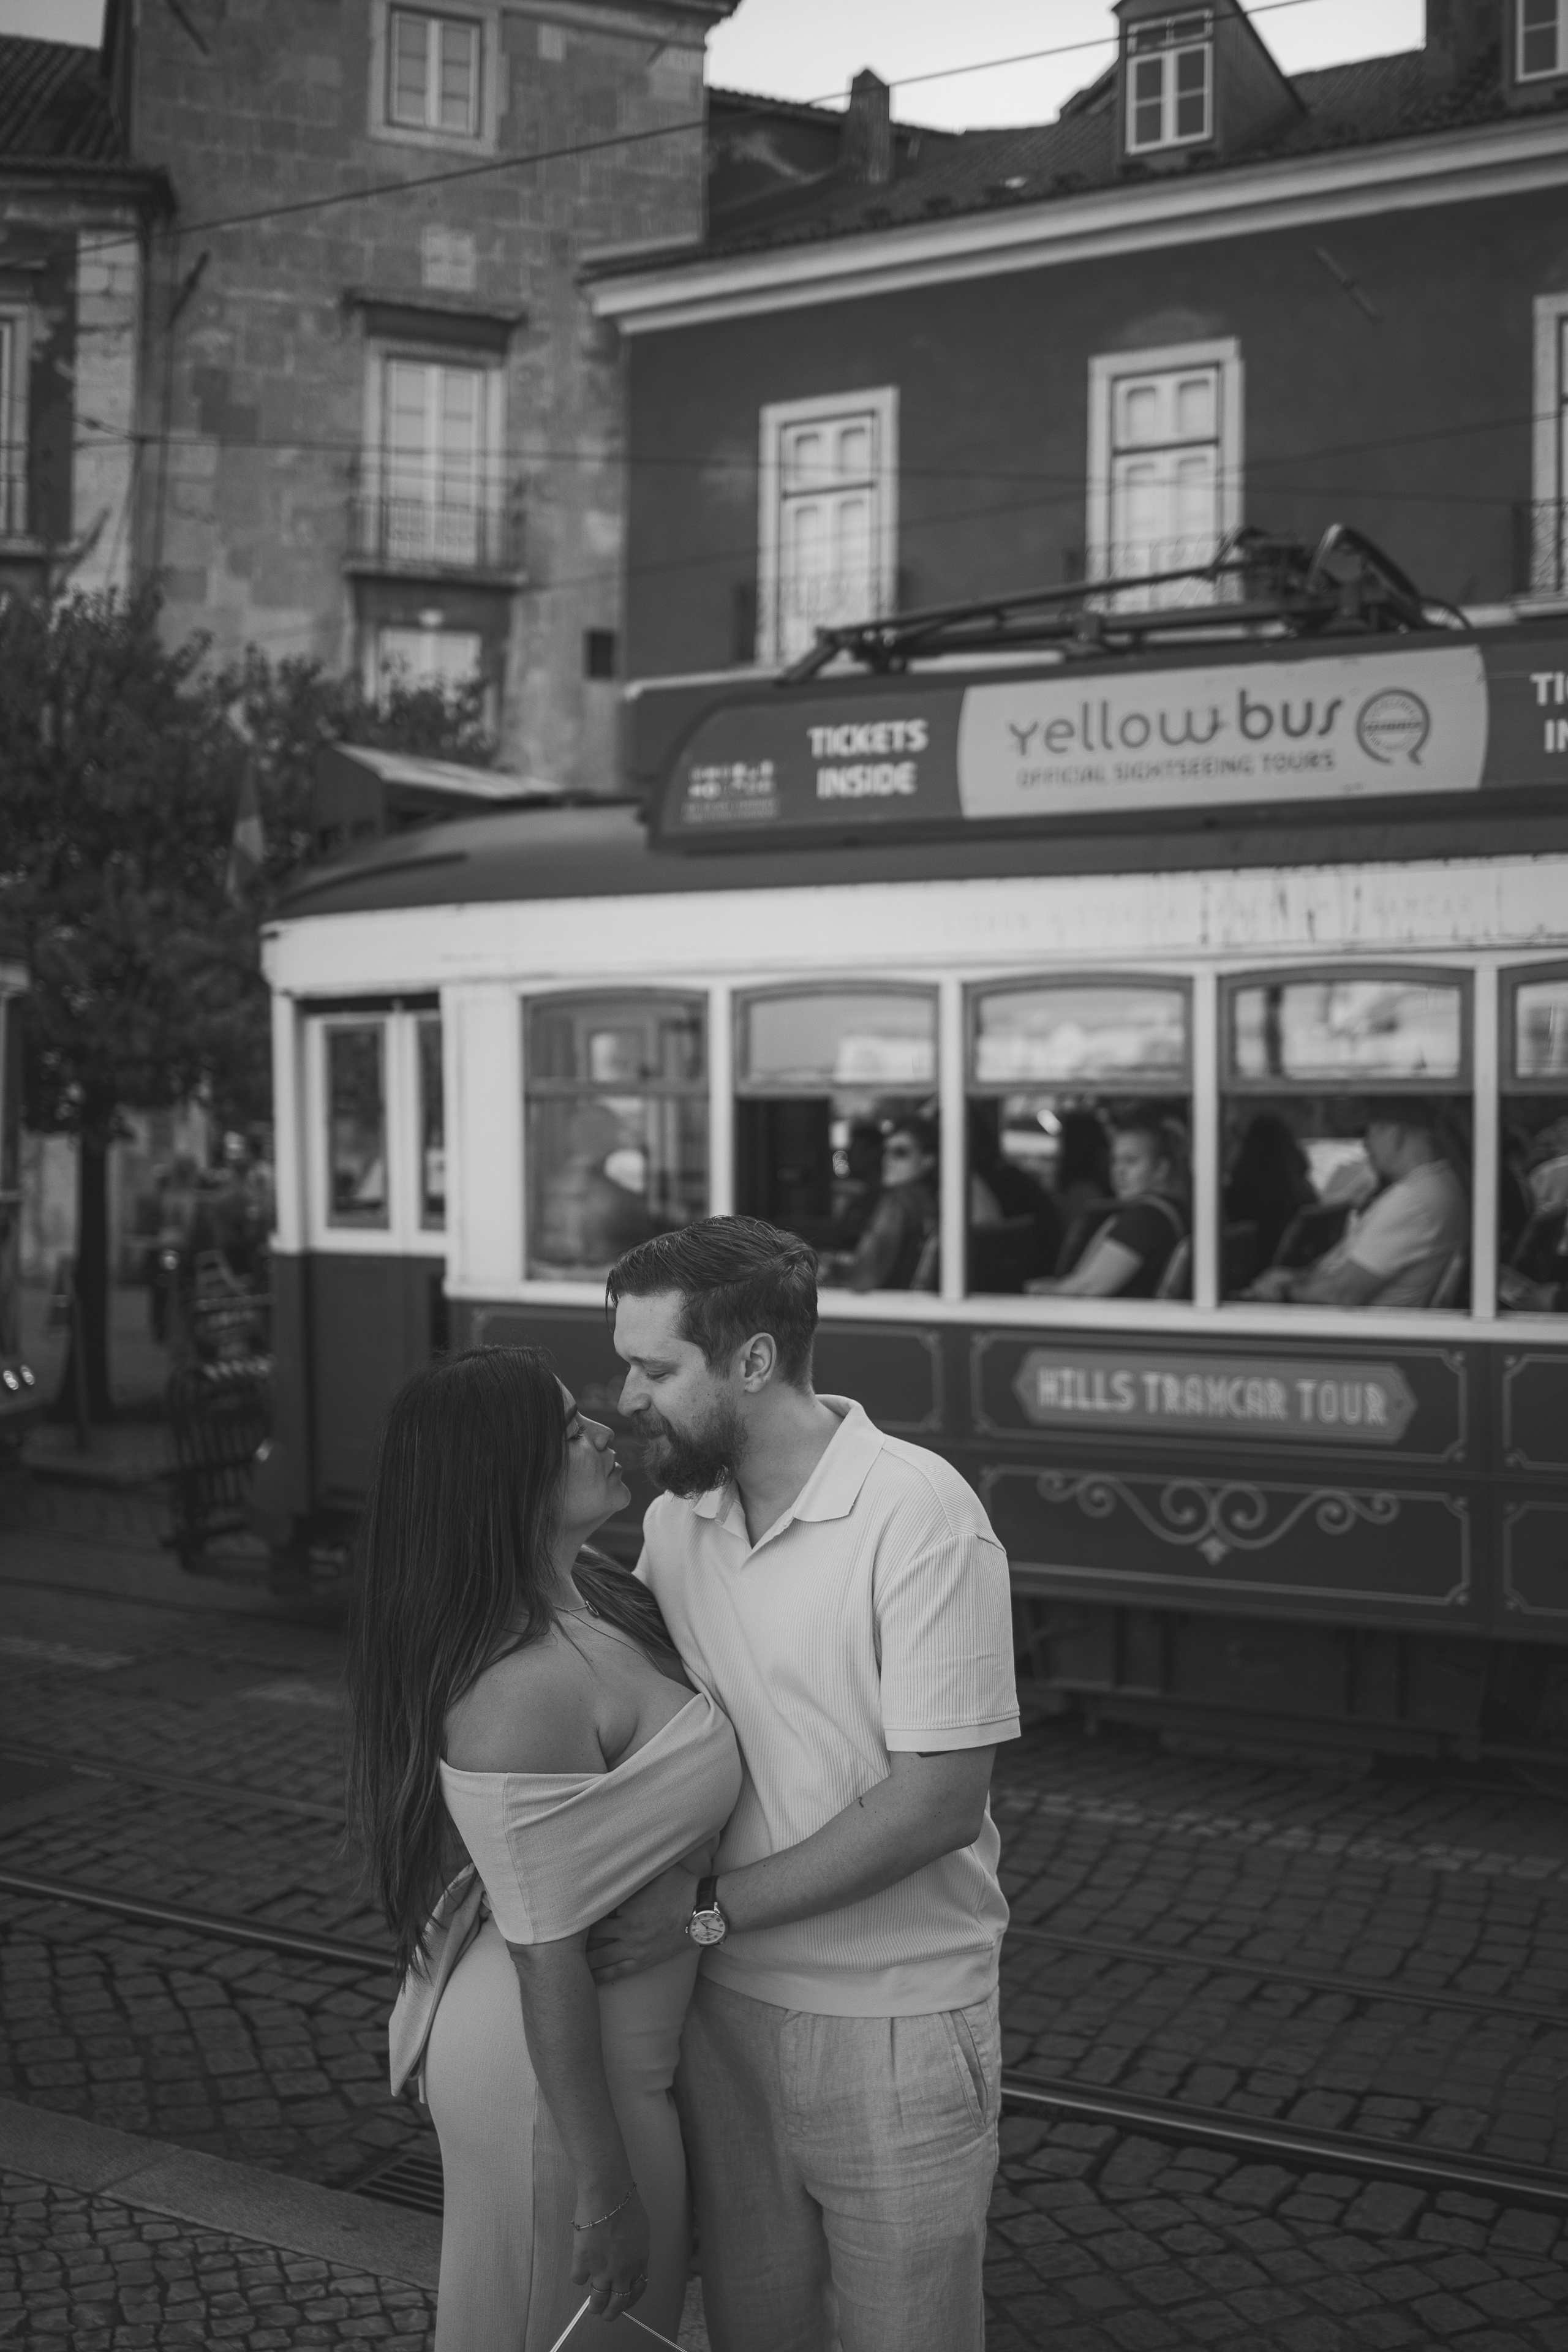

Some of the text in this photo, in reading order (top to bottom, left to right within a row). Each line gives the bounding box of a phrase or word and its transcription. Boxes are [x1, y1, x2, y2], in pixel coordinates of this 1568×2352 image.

[1530, 671, 1568, 706] TI
[808, 719, 929, 758] TICKETS
[816, 761, 918, 799] INSIDE
[1017, 747, 1336, 790] OFFICIAL SIGHTSEEING TOURS
[1036, 1366, 1388, 1426] HILLS TRAMCAR TOUR
